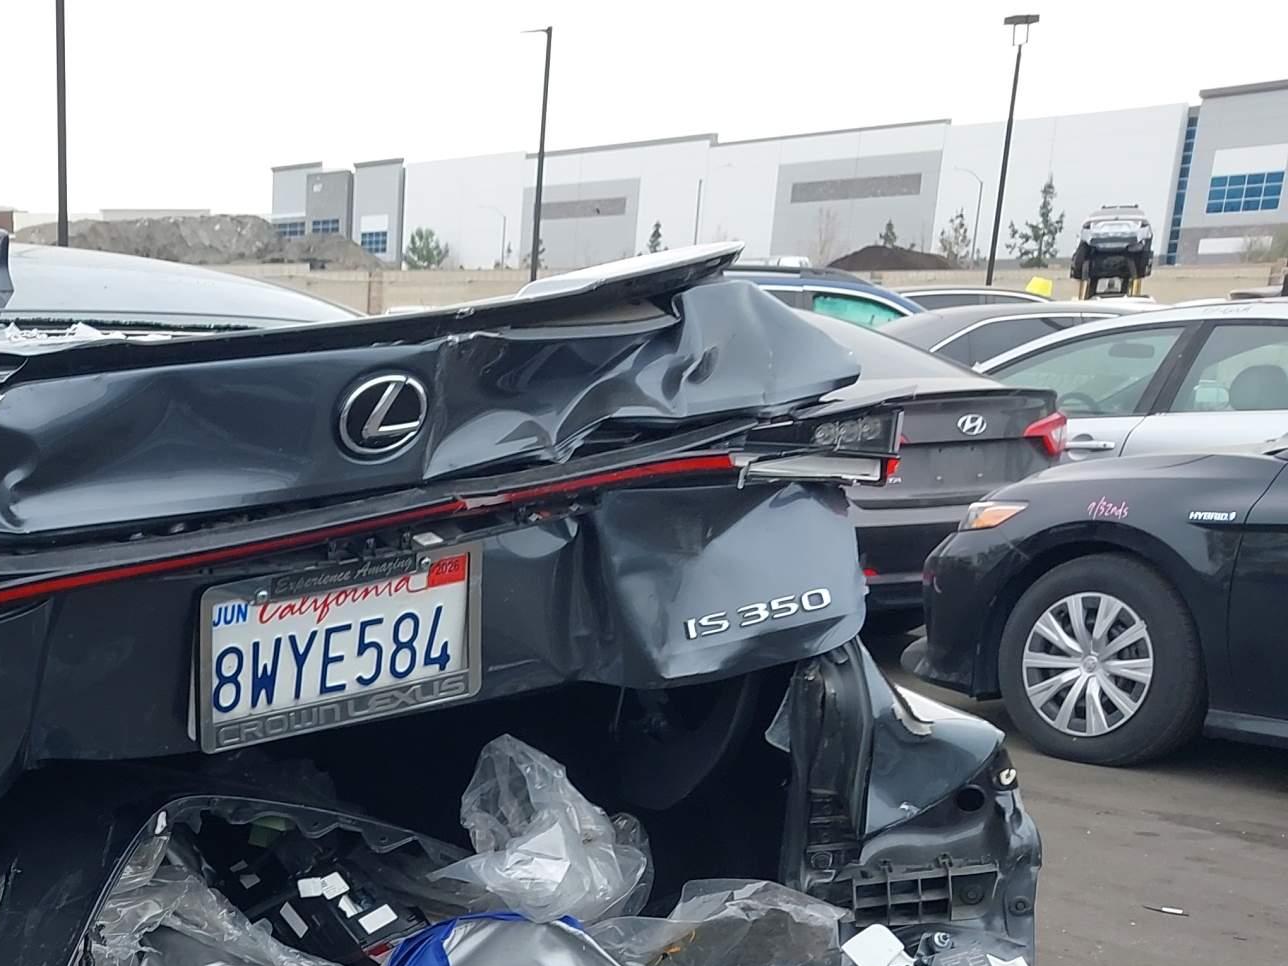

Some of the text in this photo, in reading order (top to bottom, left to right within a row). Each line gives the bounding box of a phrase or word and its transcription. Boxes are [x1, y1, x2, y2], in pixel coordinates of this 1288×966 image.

[259, 573, 428, 624] California
[275, 557, 412, 593] Experience Amazing
[213, 602, 248, 627] JUN
[684, 587, 832, 640] IS 350
[213, 605, 450, 713] 8WYE584
[218, 675, 466, 745] CROWN LEXUS
